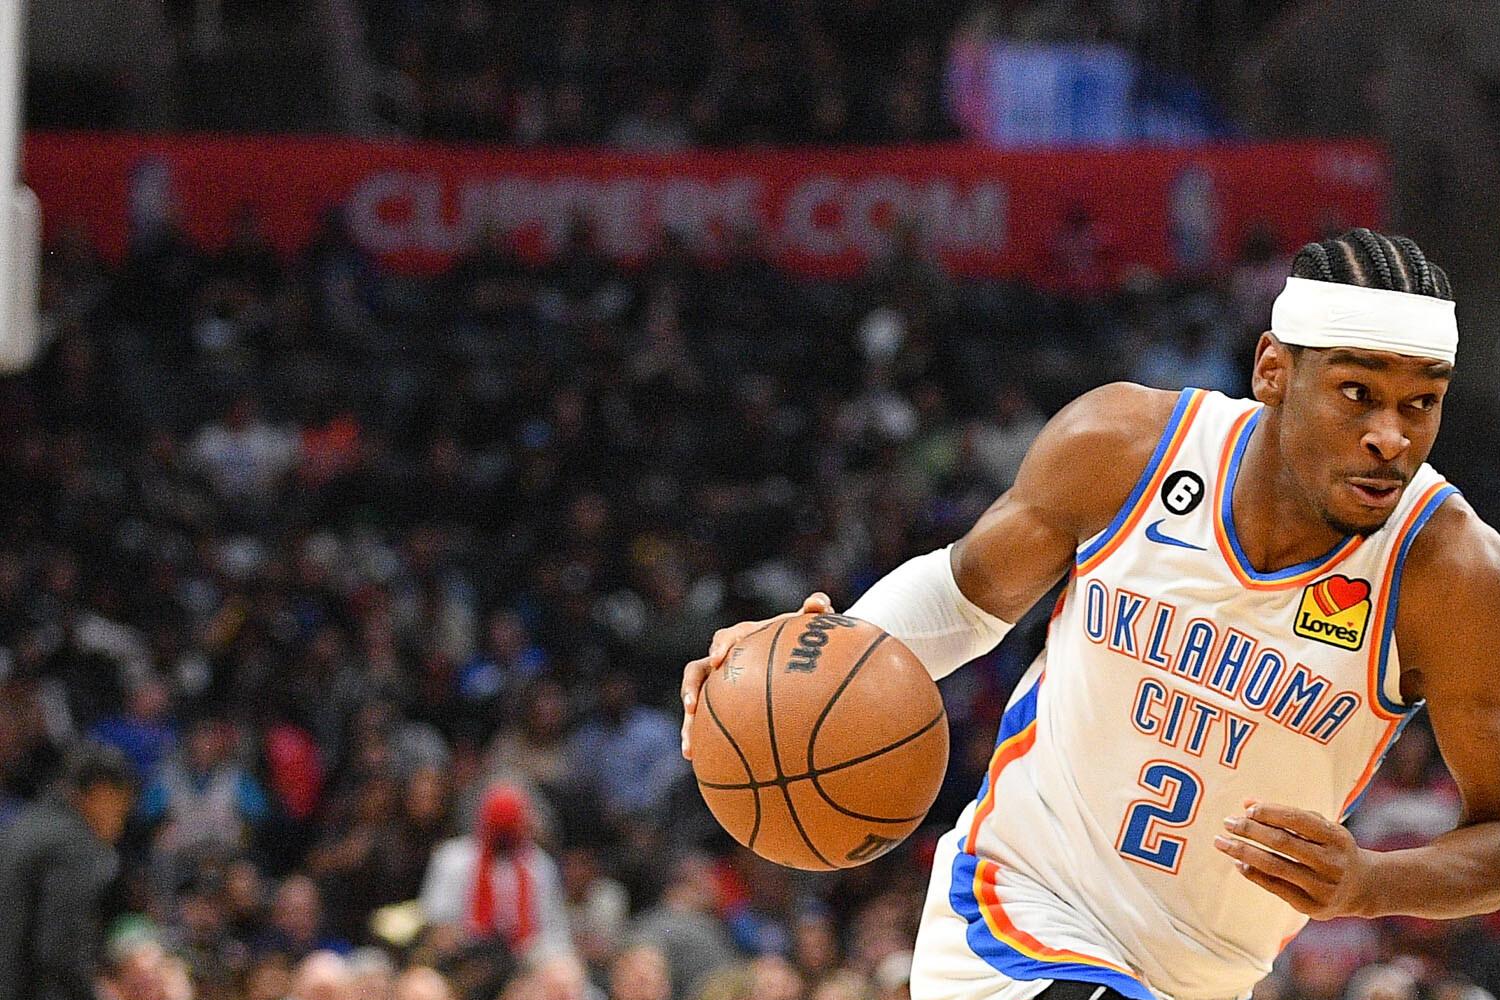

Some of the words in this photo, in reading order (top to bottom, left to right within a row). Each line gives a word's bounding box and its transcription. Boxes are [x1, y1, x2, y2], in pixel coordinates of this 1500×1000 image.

[1166, 476, 1200, 511] 6
[1084, 579, 1361, 744] OKLAHOMA
[1299, 612, 1358, 643] Loves
[1131, 678, 1258, 769] CITY
[1115, 759, 1204, 875] 2
